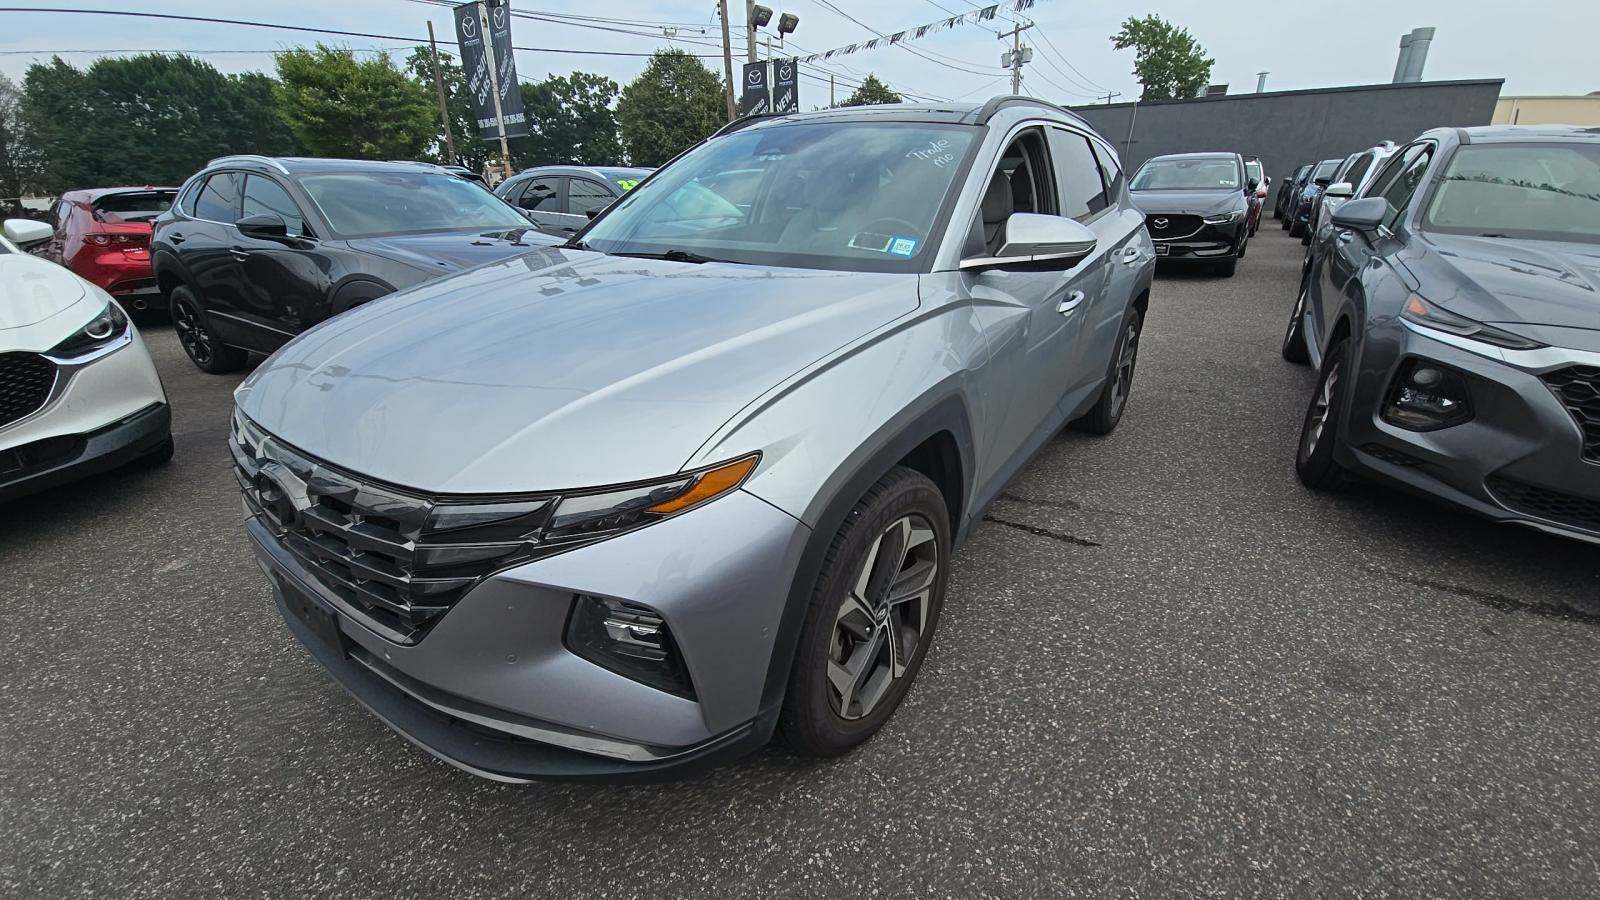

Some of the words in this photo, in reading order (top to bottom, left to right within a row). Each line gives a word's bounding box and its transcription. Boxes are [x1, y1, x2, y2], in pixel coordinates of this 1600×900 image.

[469, 73, 480, 94] WE
[478, 75, 491, 106] CARS
[776, 88, 792, 113] NEW
[905, 139, 949, 161] Trade
